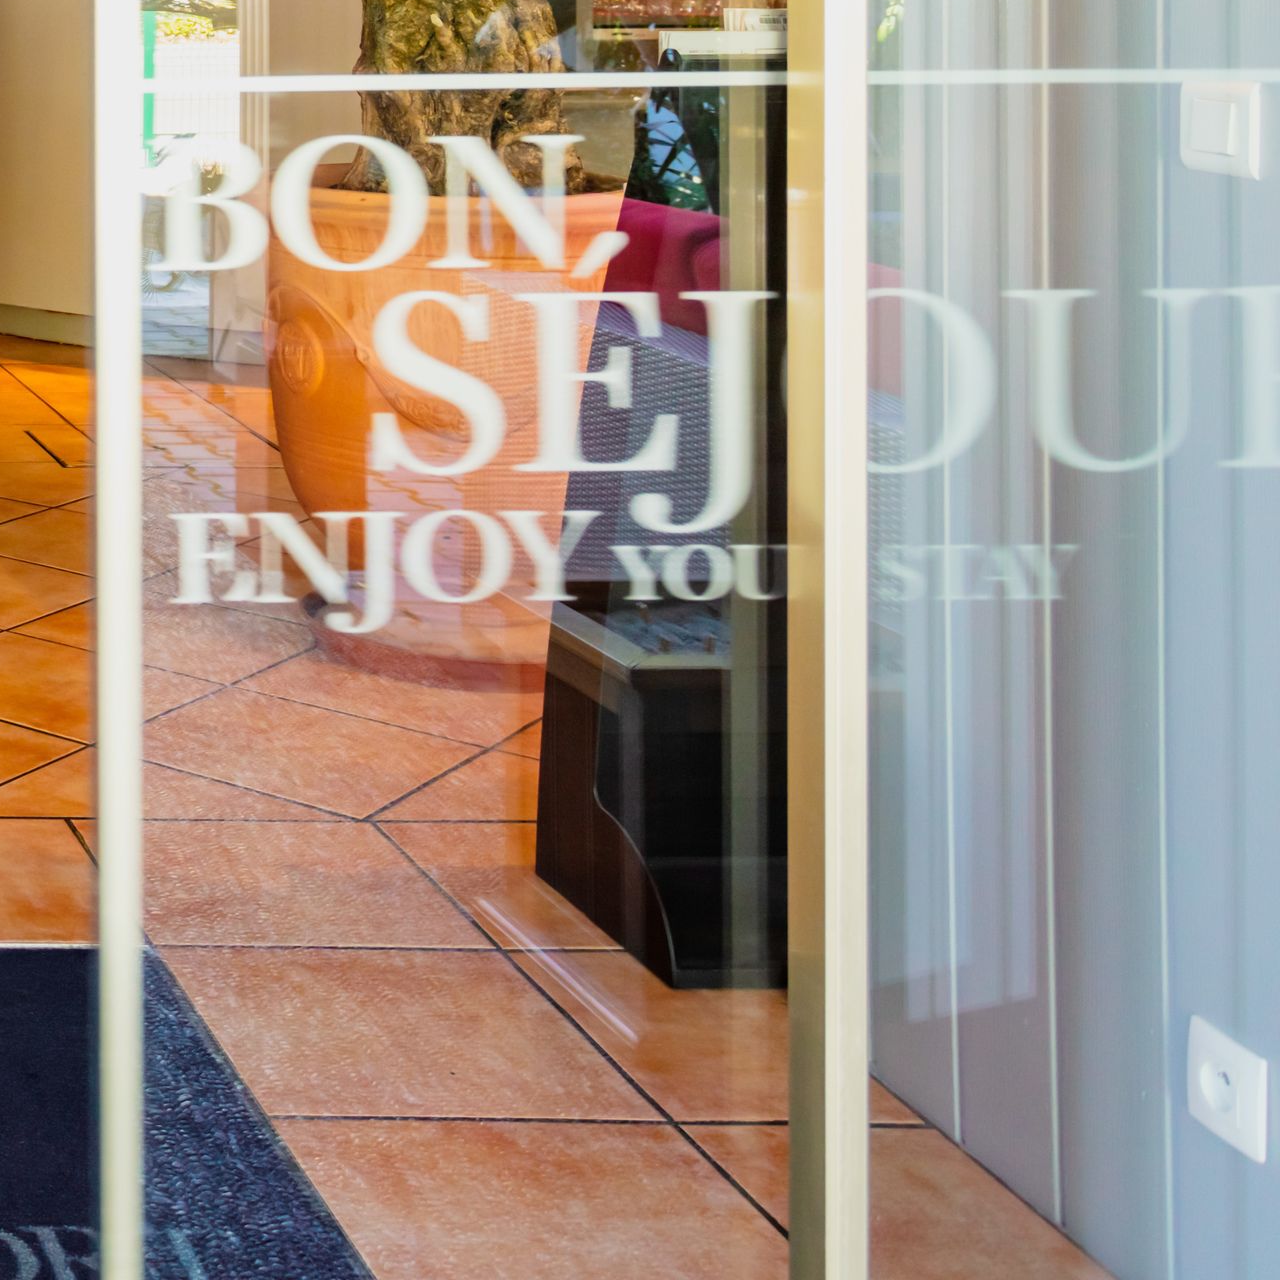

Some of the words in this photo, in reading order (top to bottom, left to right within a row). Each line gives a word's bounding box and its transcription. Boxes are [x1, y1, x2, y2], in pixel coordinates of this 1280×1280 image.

[169, 510, 602, 634] ENJOY
[612, 544, 805, 602] YOU
[877, 544, 1080, 601] STAY
